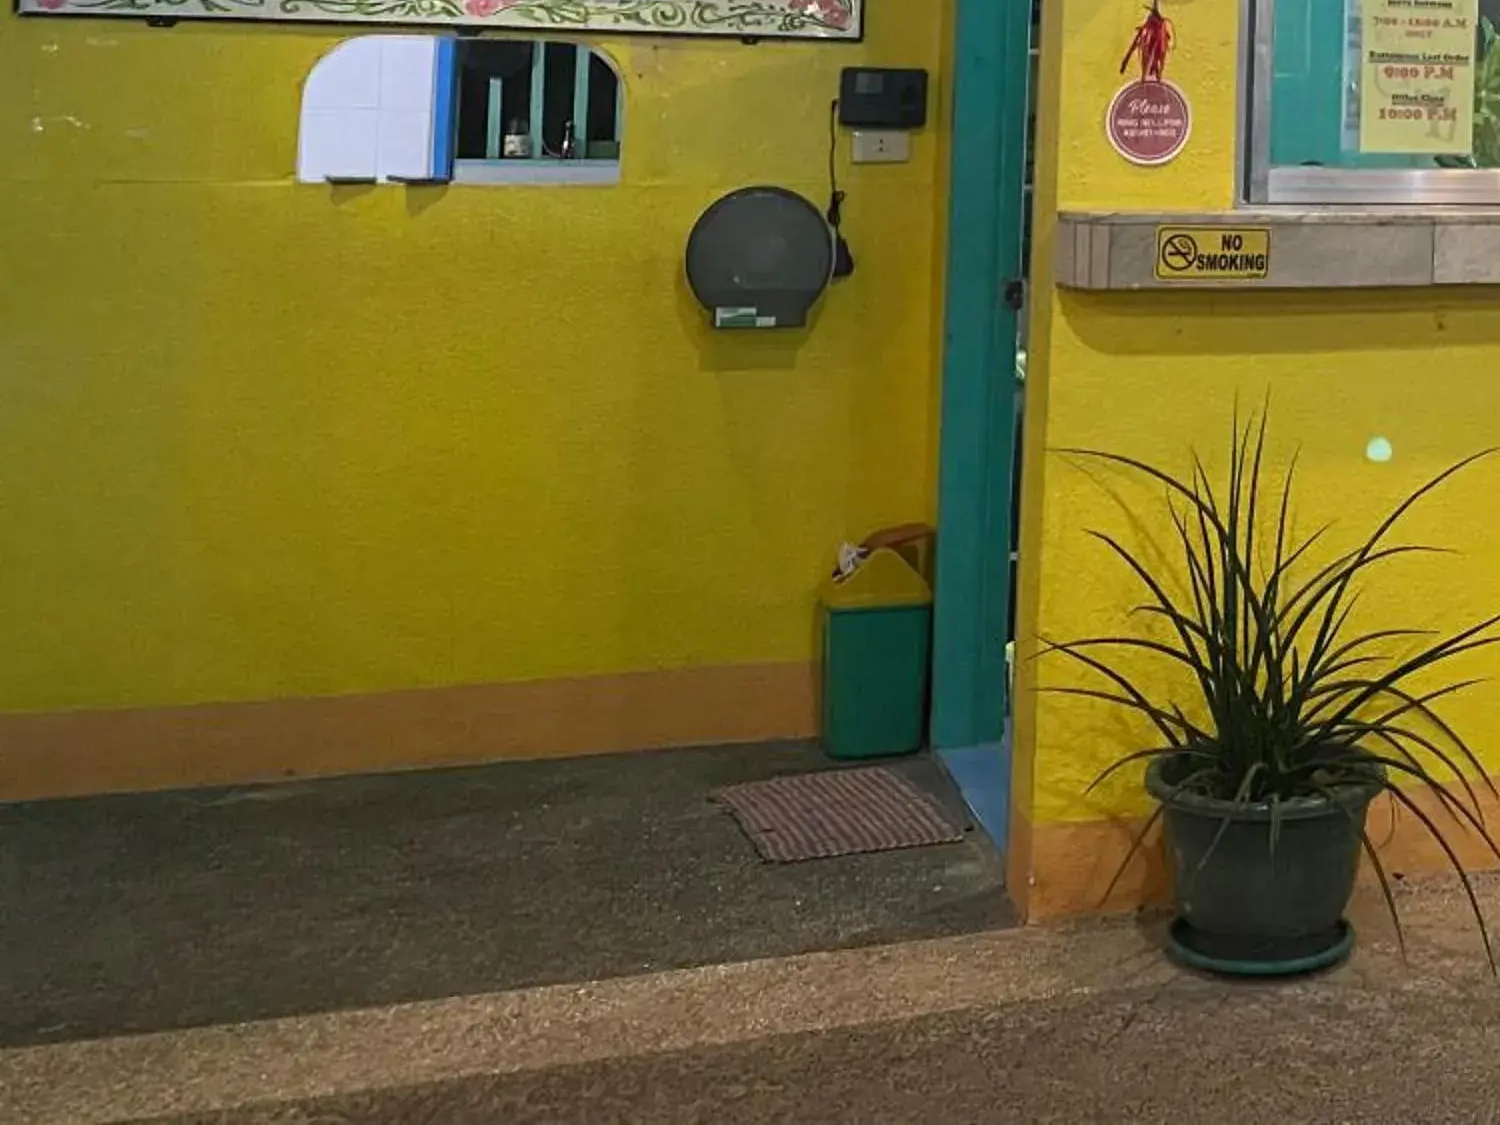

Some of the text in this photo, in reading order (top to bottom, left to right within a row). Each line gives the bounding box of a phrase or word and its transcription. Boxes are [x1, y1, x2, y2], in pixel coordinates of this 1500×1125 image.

[1127, 98, 1170, 116] Please
[1221, 234, 1243, 252] NO
[1196, 254, 1266, 272] SMOKING
